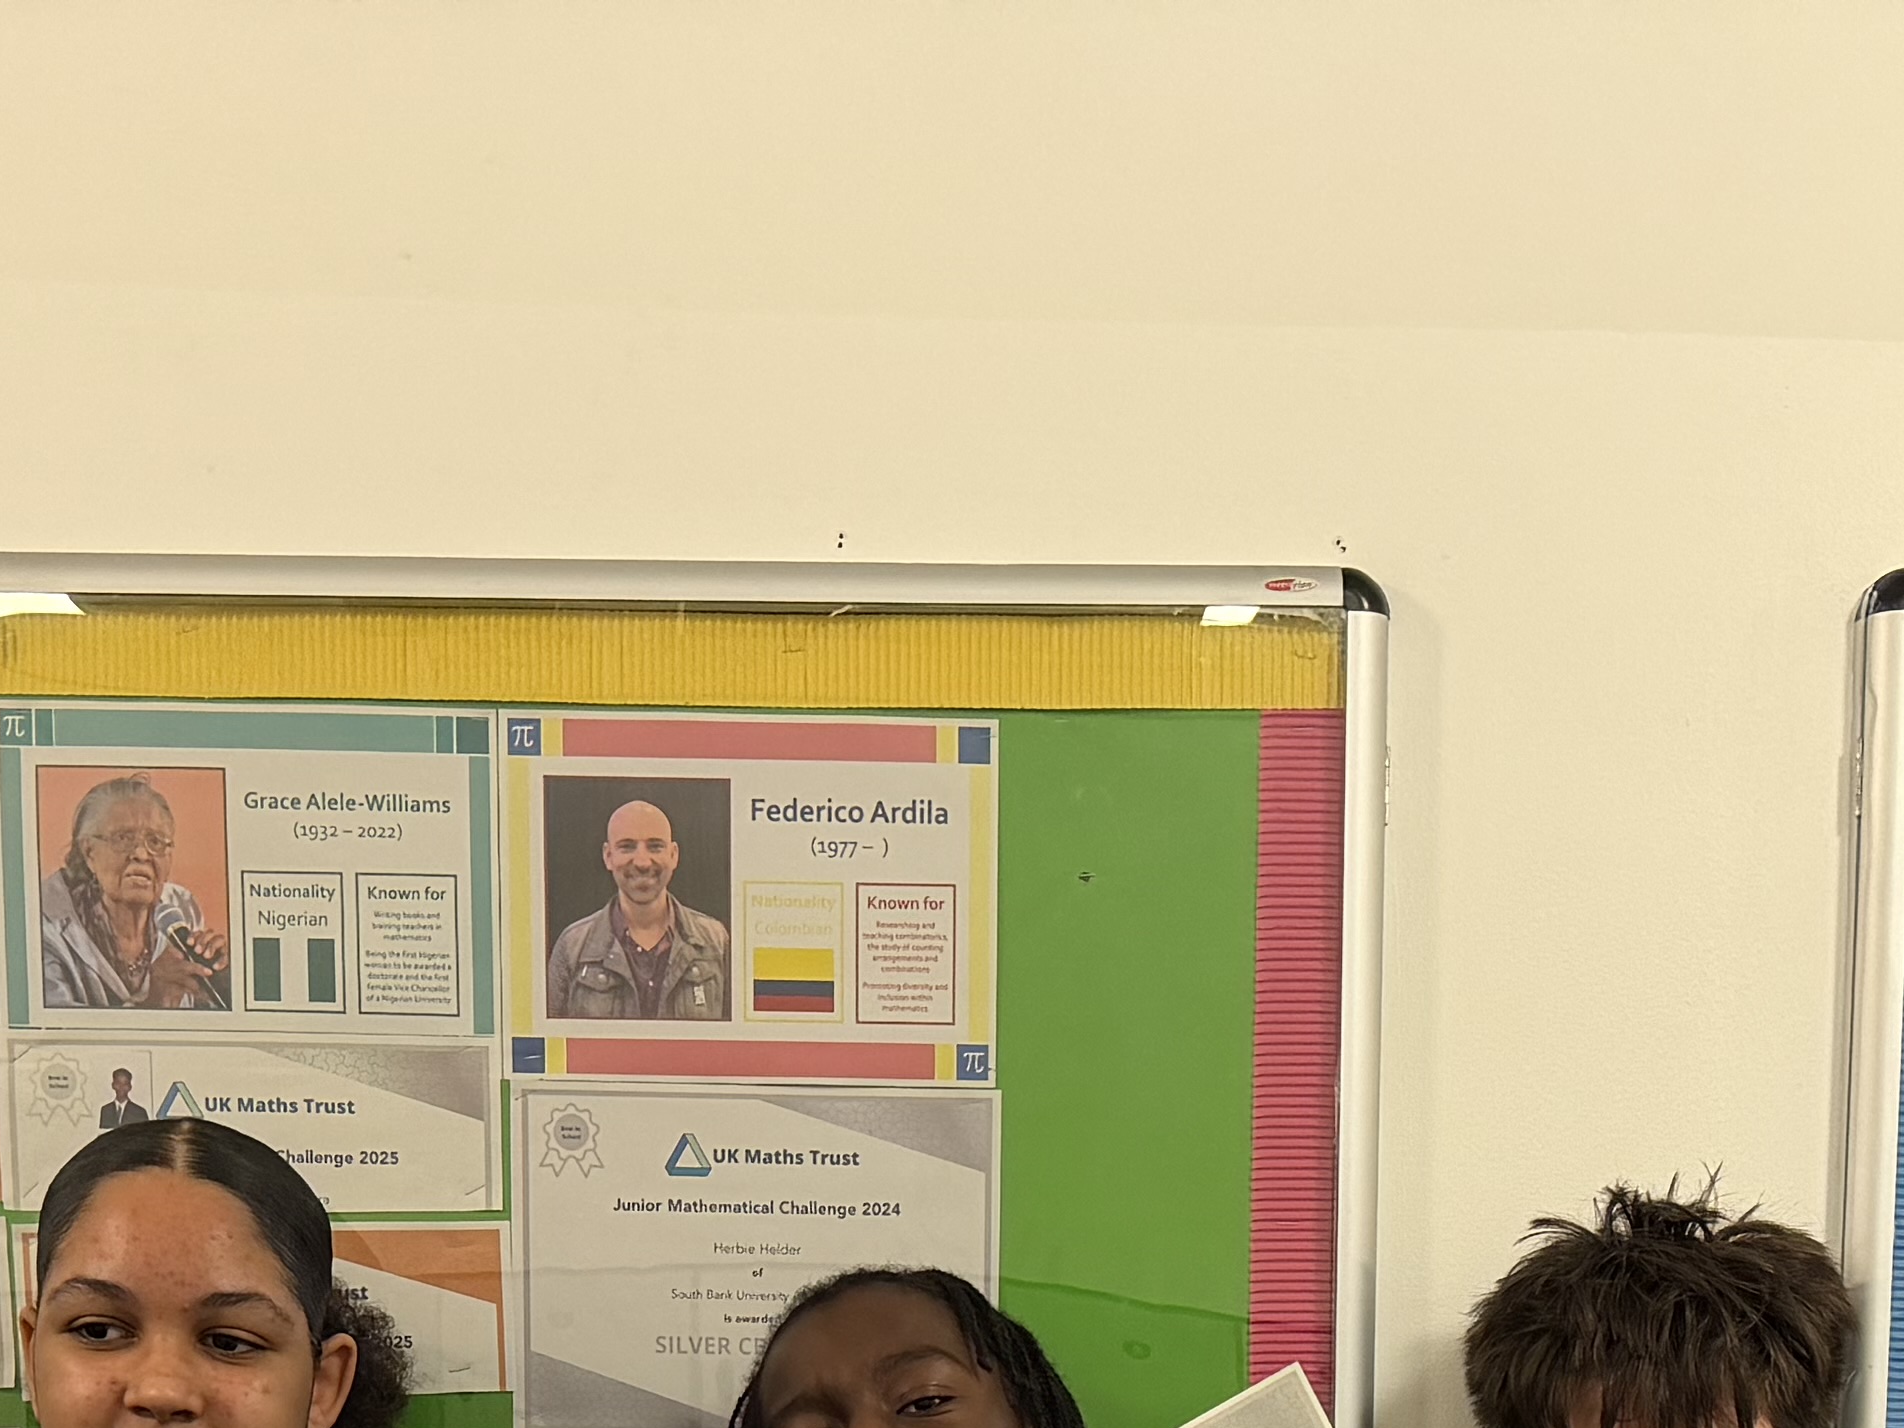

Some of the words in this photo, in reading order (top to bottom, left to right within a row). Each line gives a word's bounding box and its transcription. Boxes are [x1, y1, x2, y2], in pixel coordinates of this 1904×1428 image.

[244, 792, 301, 810] Grace
[306, 792, 450, 813] Alele-Williams
[751, 797, 864, 823] Federico
[870, 799, 948, 824] Ardila
[294, 822, 338, 841] (1932
[358, 823, 402, 841] 2022)
[250, 883, 335, 902] Nationality
[868, 896, 919, 910] Known
[923, 896, 945, 910] for
[258, 910, 328, 930] Nigerian
